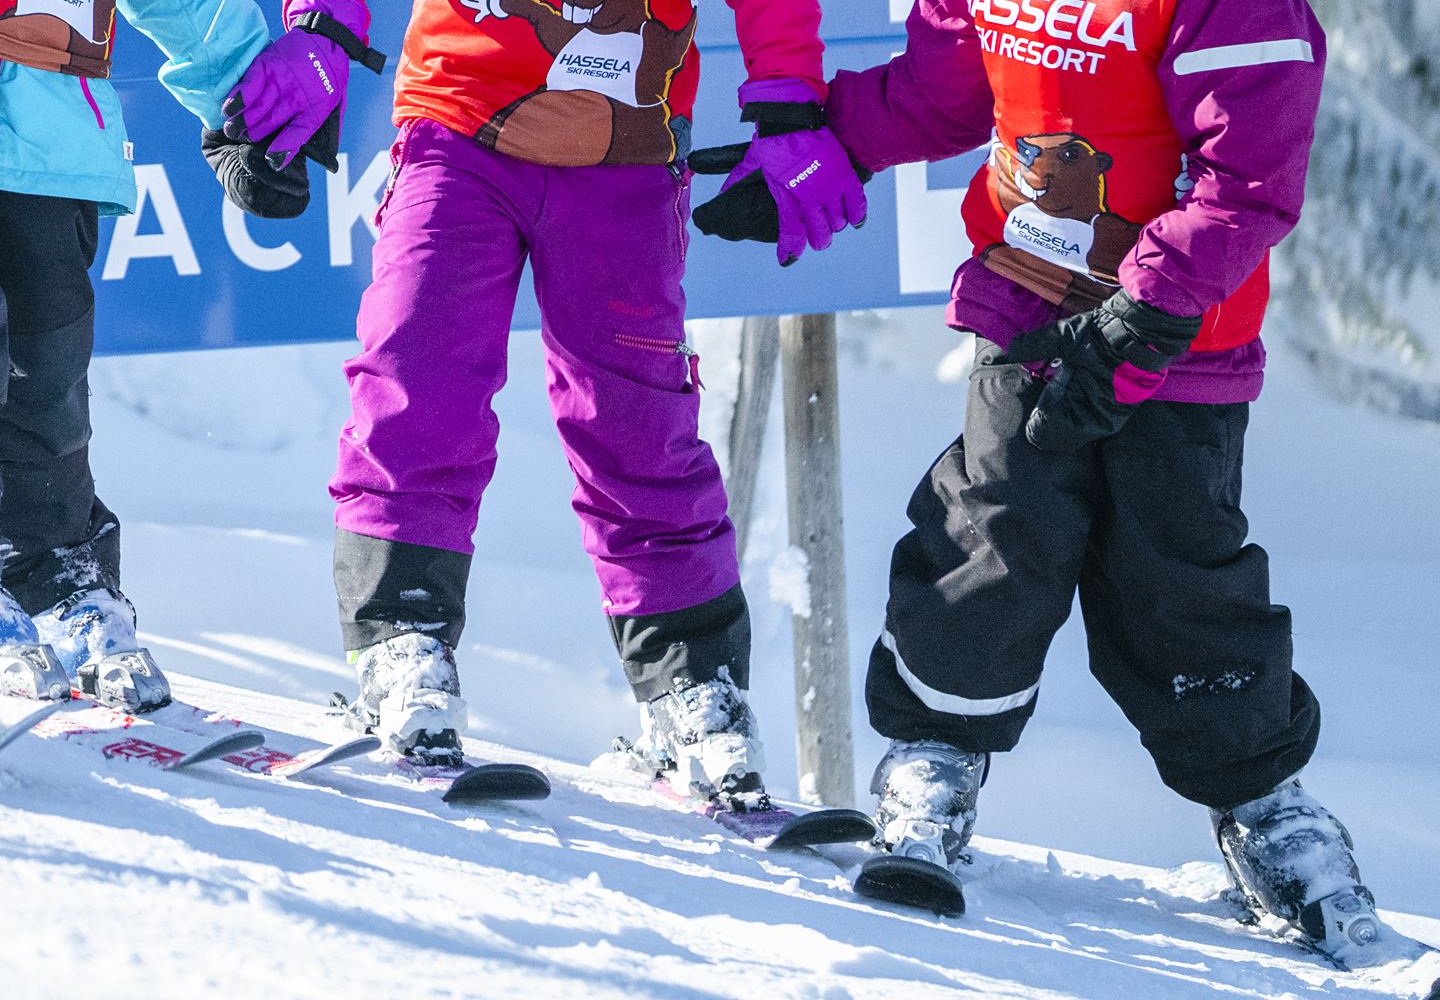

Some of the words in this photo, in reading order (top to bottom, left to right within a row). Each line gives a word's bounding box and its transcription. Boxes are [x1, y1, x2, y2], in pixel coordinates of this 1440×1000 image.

[559, 53, 631, 73] HASSELA
[999, 33, 1105, 75] RESORT
[313, 60, 334, 95] everest
[566, 66, 583, 75] SKI
[583, 68, 621, 80] RESORT
[789, 160, 821, 188] everest
[1011, 215, 1081, 254] HASSELA
[1017, 230, 1033, 242] SKI
[1033, 239, 1070, 257] RESORT
